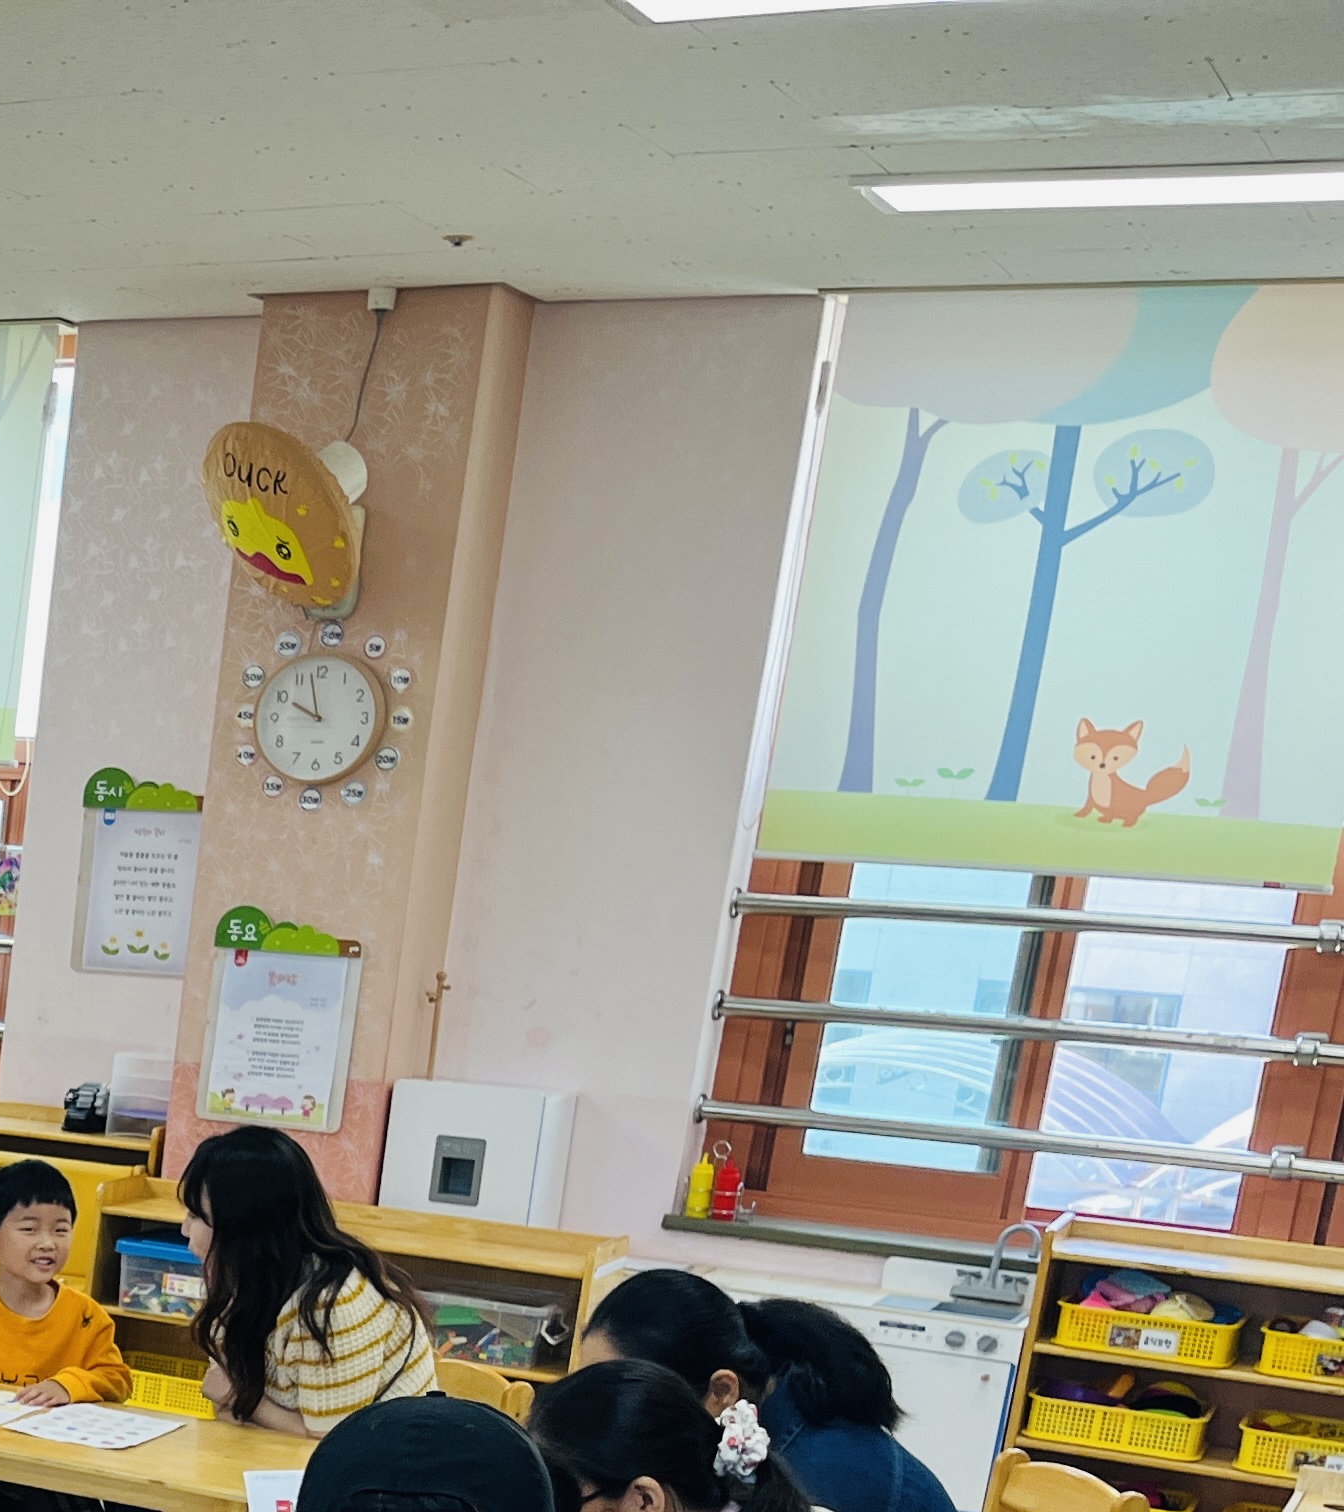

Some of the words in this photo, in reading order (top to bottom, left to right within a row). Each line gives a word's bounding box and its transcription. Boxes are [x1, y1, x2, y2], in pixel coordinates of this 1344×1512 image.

[316, 665, 328, 679] 12
[295, 672, 304, 686] 11
[276, 690, 289, 703] 10
[356, 689, 365, 702] 2
[270, 712, 279, 723] 9
[360, 711, 369, 725] 3
[275, 735, 284, 748] 8
[351, 734, 360, 747] 4
[292, 752, 301, 765] 7
[311, 758, 320, 771] 6
[333, 752, 343, 765] 5
[94, 780, 123, 802] 동시
[226, 919, 258, 942] 동요
